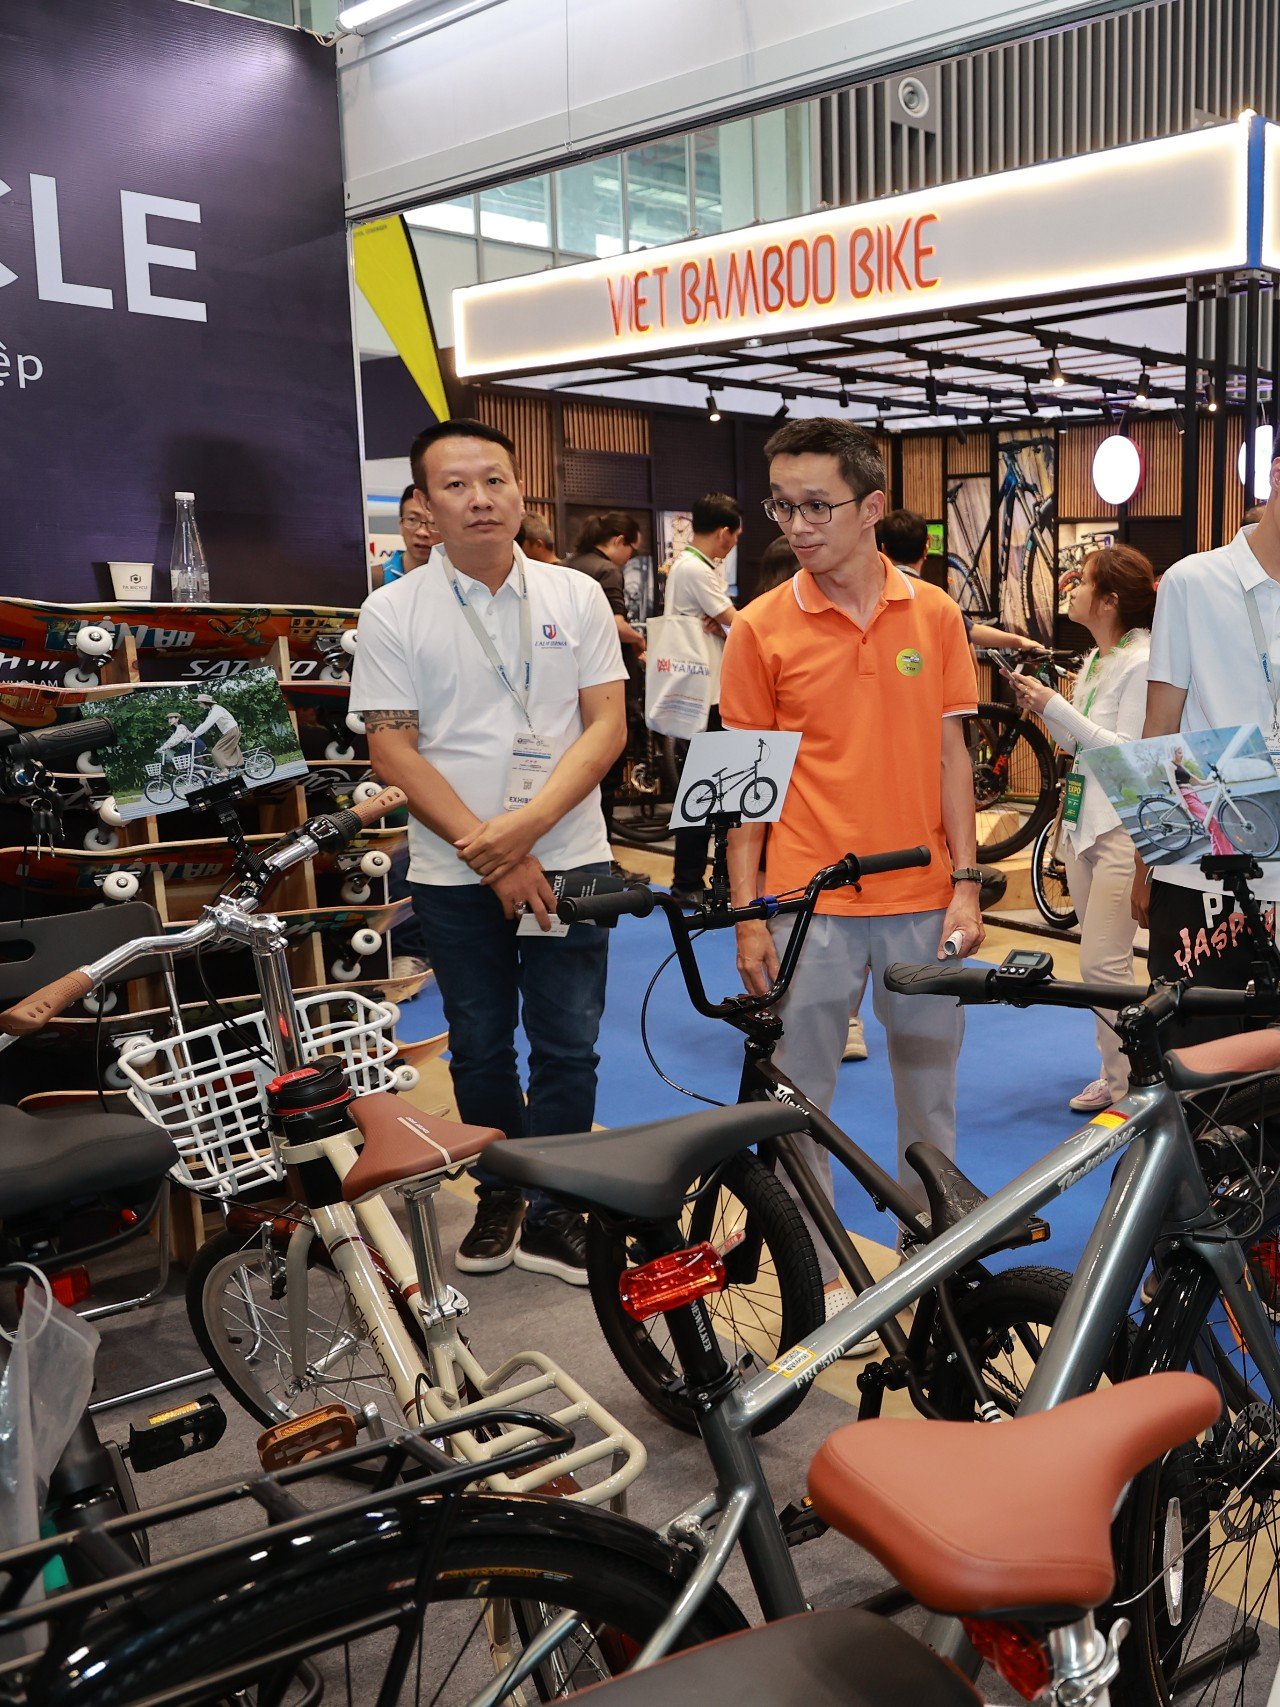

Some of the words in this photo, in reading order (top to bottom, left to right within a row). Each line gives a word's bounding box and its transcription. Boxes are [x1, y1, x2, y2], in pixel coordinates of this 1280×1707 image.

[0, 173, 208, 321] LE
[606, 265, 669, 336] VIET
[680, 232, 838, 325] BAMBOO
[848, 212, 941, 299] BIKE
[691, 1301, 713, 1353] MEWALKER
